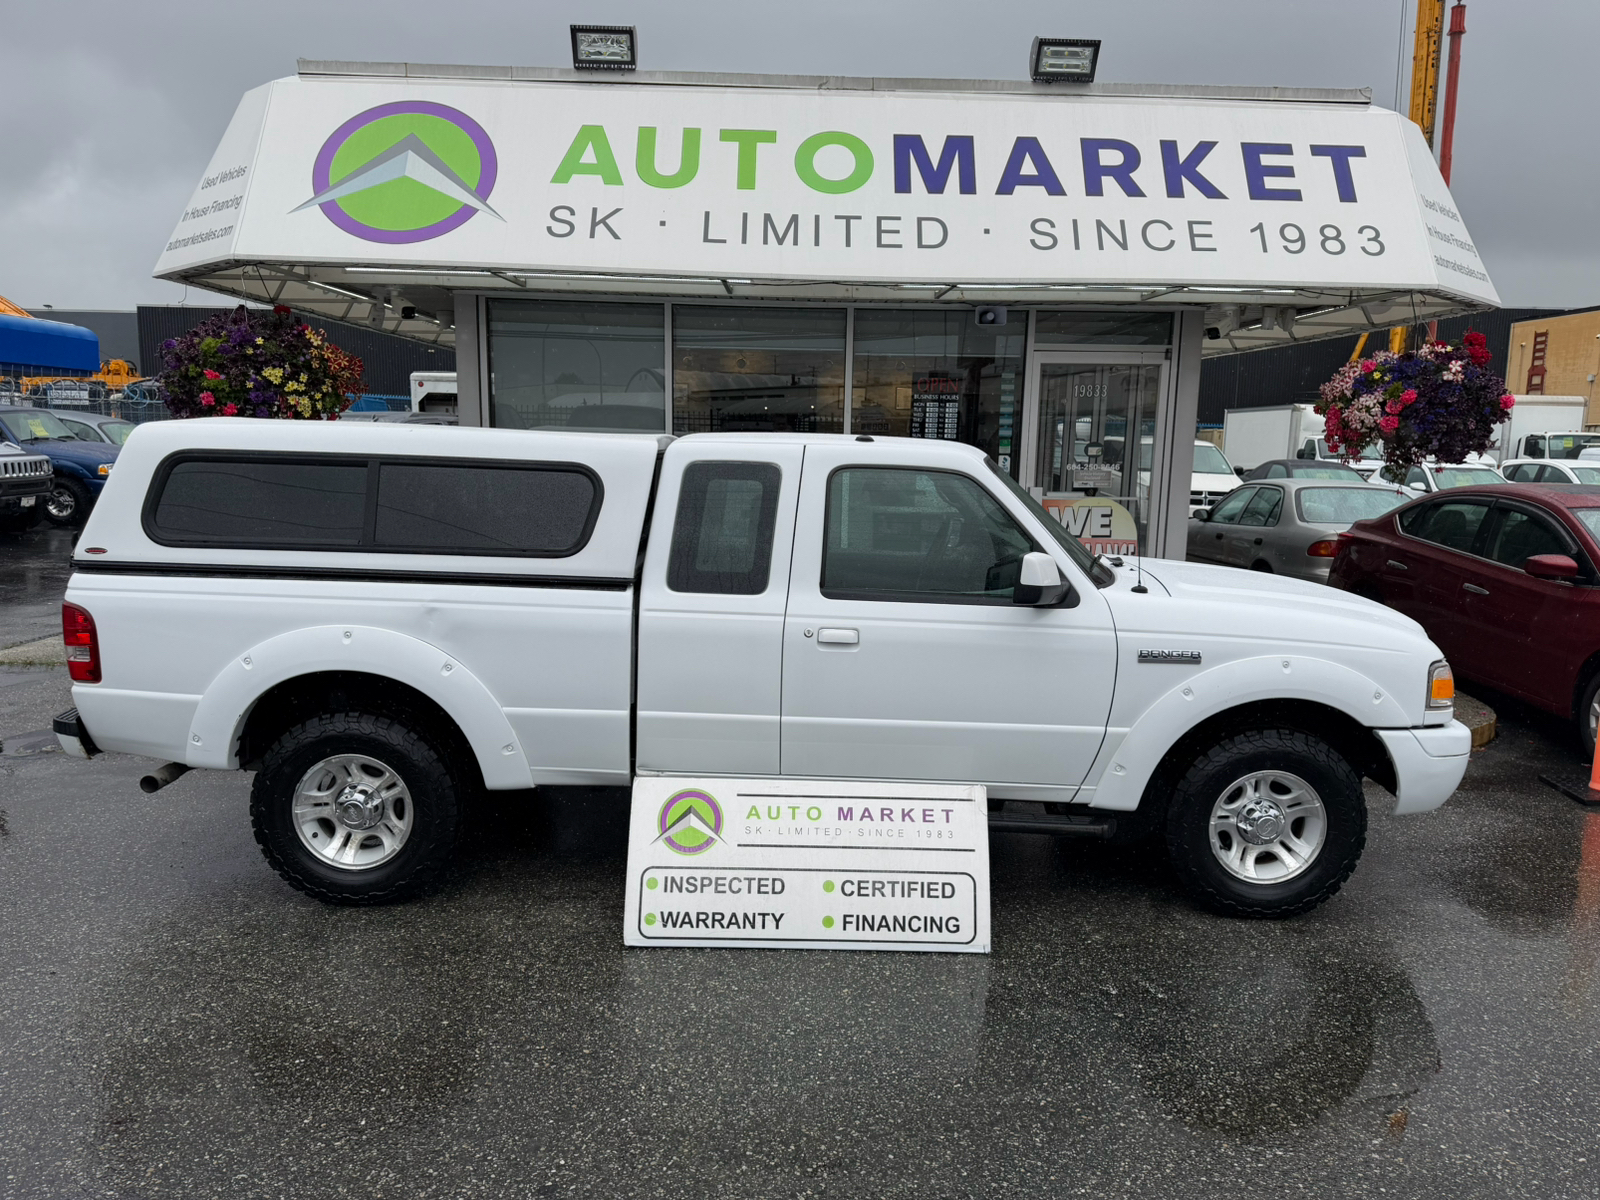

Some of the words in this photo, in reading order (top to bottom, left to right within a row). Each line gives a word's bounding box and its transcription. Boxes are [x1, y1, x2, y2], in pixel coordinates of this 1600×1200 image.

[201, 172, 221, 190] Used
[219, 165, 247, 184] Vehicles
[181, 209, 190, 222] In
[188, 206, 210, 220] House
[209, 194, 243, 215] Financing
[166, 225, 234, 252] automarketsales.com
[546, 205, 624, 240] SK
[702, 210, 949, 249] LIMITED
[1029, 217, 1218, 252] SINCE
[1250, 221, 1387, 257] 1983
[917, 377, 959, 392] OPEN
[1074, 385, 1108, 398] 19833
[1047, 506, 1112, 538] WE
[1138, 648, 1202, 660] RANGER
[746, 805, 823, 821] AUTO
[837, 806, 954, 824] MARKET
[744, 826, 763, 835] SK
[778, 827, 842, 837] LIMITED
[857, 828, 905, 838] SINCE
[916, 830, 954, 839] 1983
[663, 876, 785, 895] INSPECTED
[840, 879, 956, 899] CERTIFIED
[660, 911, 785, 930] WARRANTY
[842, 914, 961, 934] FINANCING
